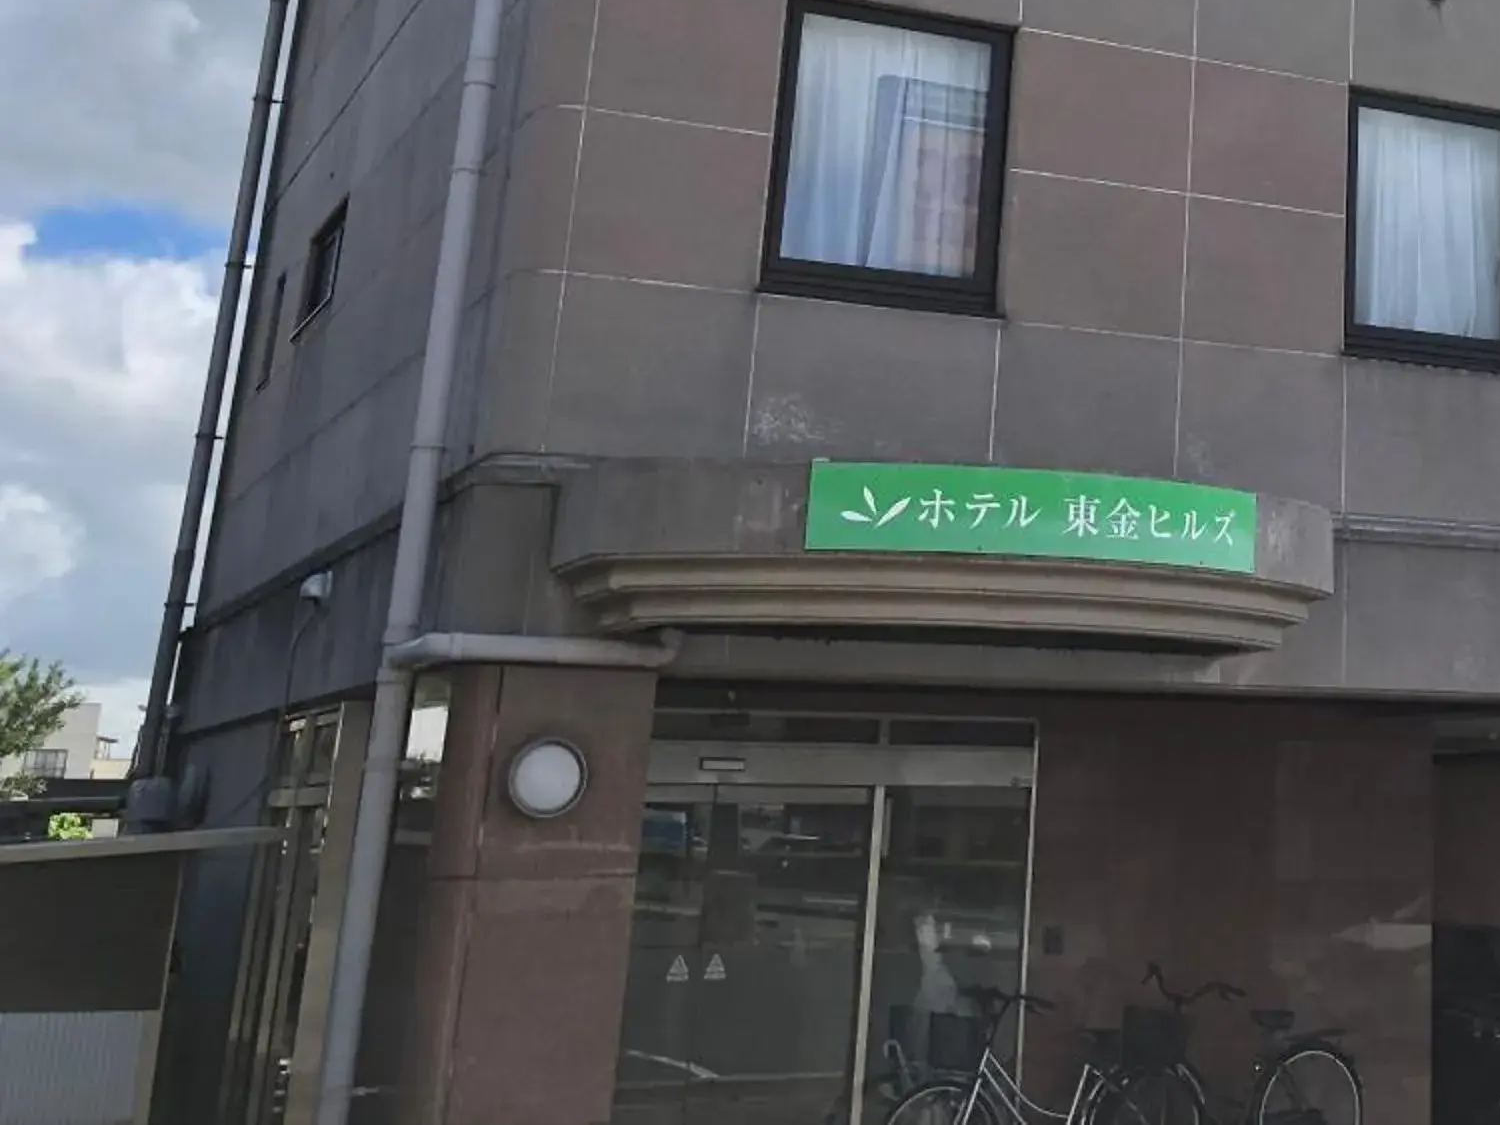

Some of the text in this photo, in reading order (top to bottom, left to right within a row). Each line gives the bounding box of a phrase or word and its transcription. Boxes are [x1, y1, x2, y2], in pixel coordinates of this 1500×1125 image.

[917, 488, 1236, 547] ホテル 東金ヒルズ
